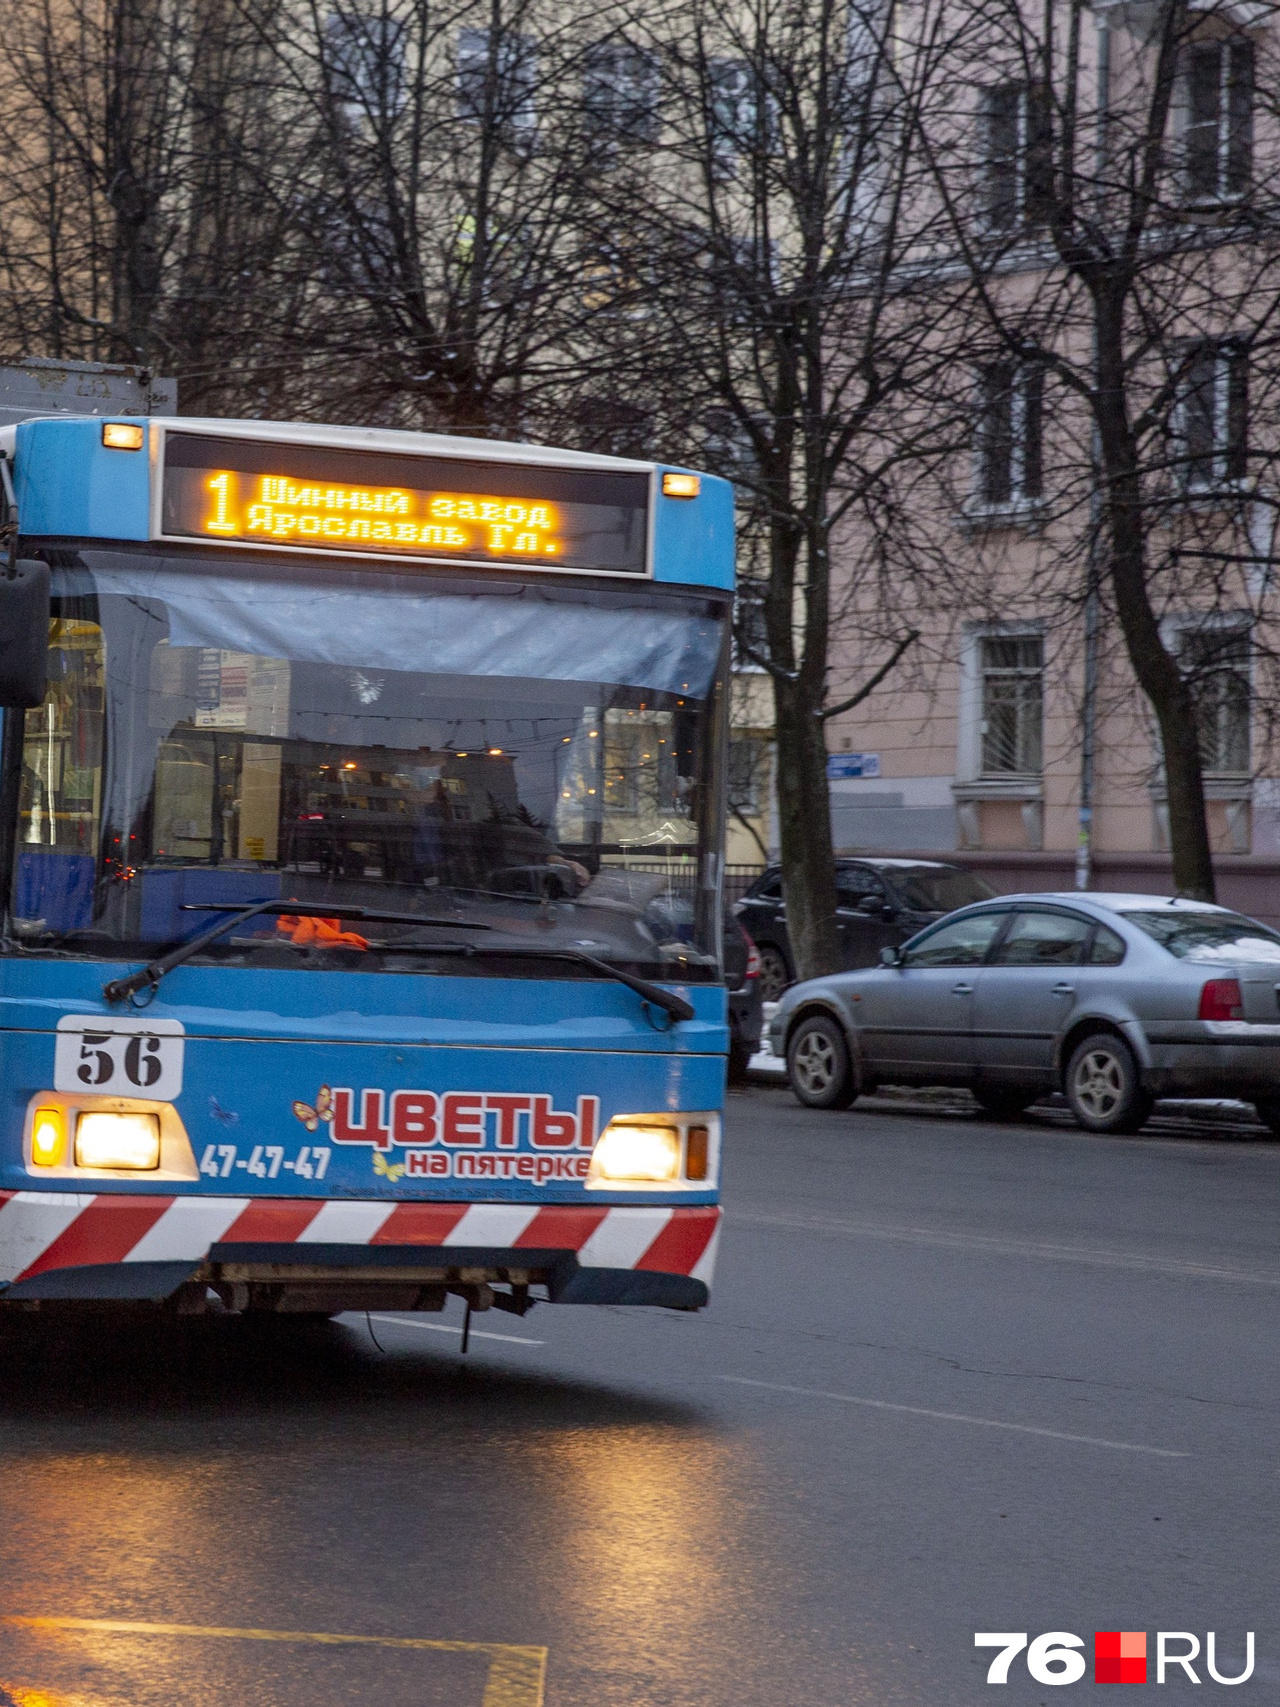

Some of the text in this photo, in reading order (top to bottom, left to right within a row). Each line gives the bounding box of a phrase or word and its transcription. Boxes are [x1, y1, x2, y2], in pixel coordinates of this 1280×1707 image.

[207, 473, 236, 531] 1
[247, 504, 557, 553] Ярославль Гл.
[260, 476, 552, 529] Шинный завод
[77, 1028, 162, 1087] 56
[332, 1090, 597, 1150] ЦВЕТЫ
[200, 1144, 332, 1180] 47-47-47
[409, 1152, 591, 1183] на пятерке
